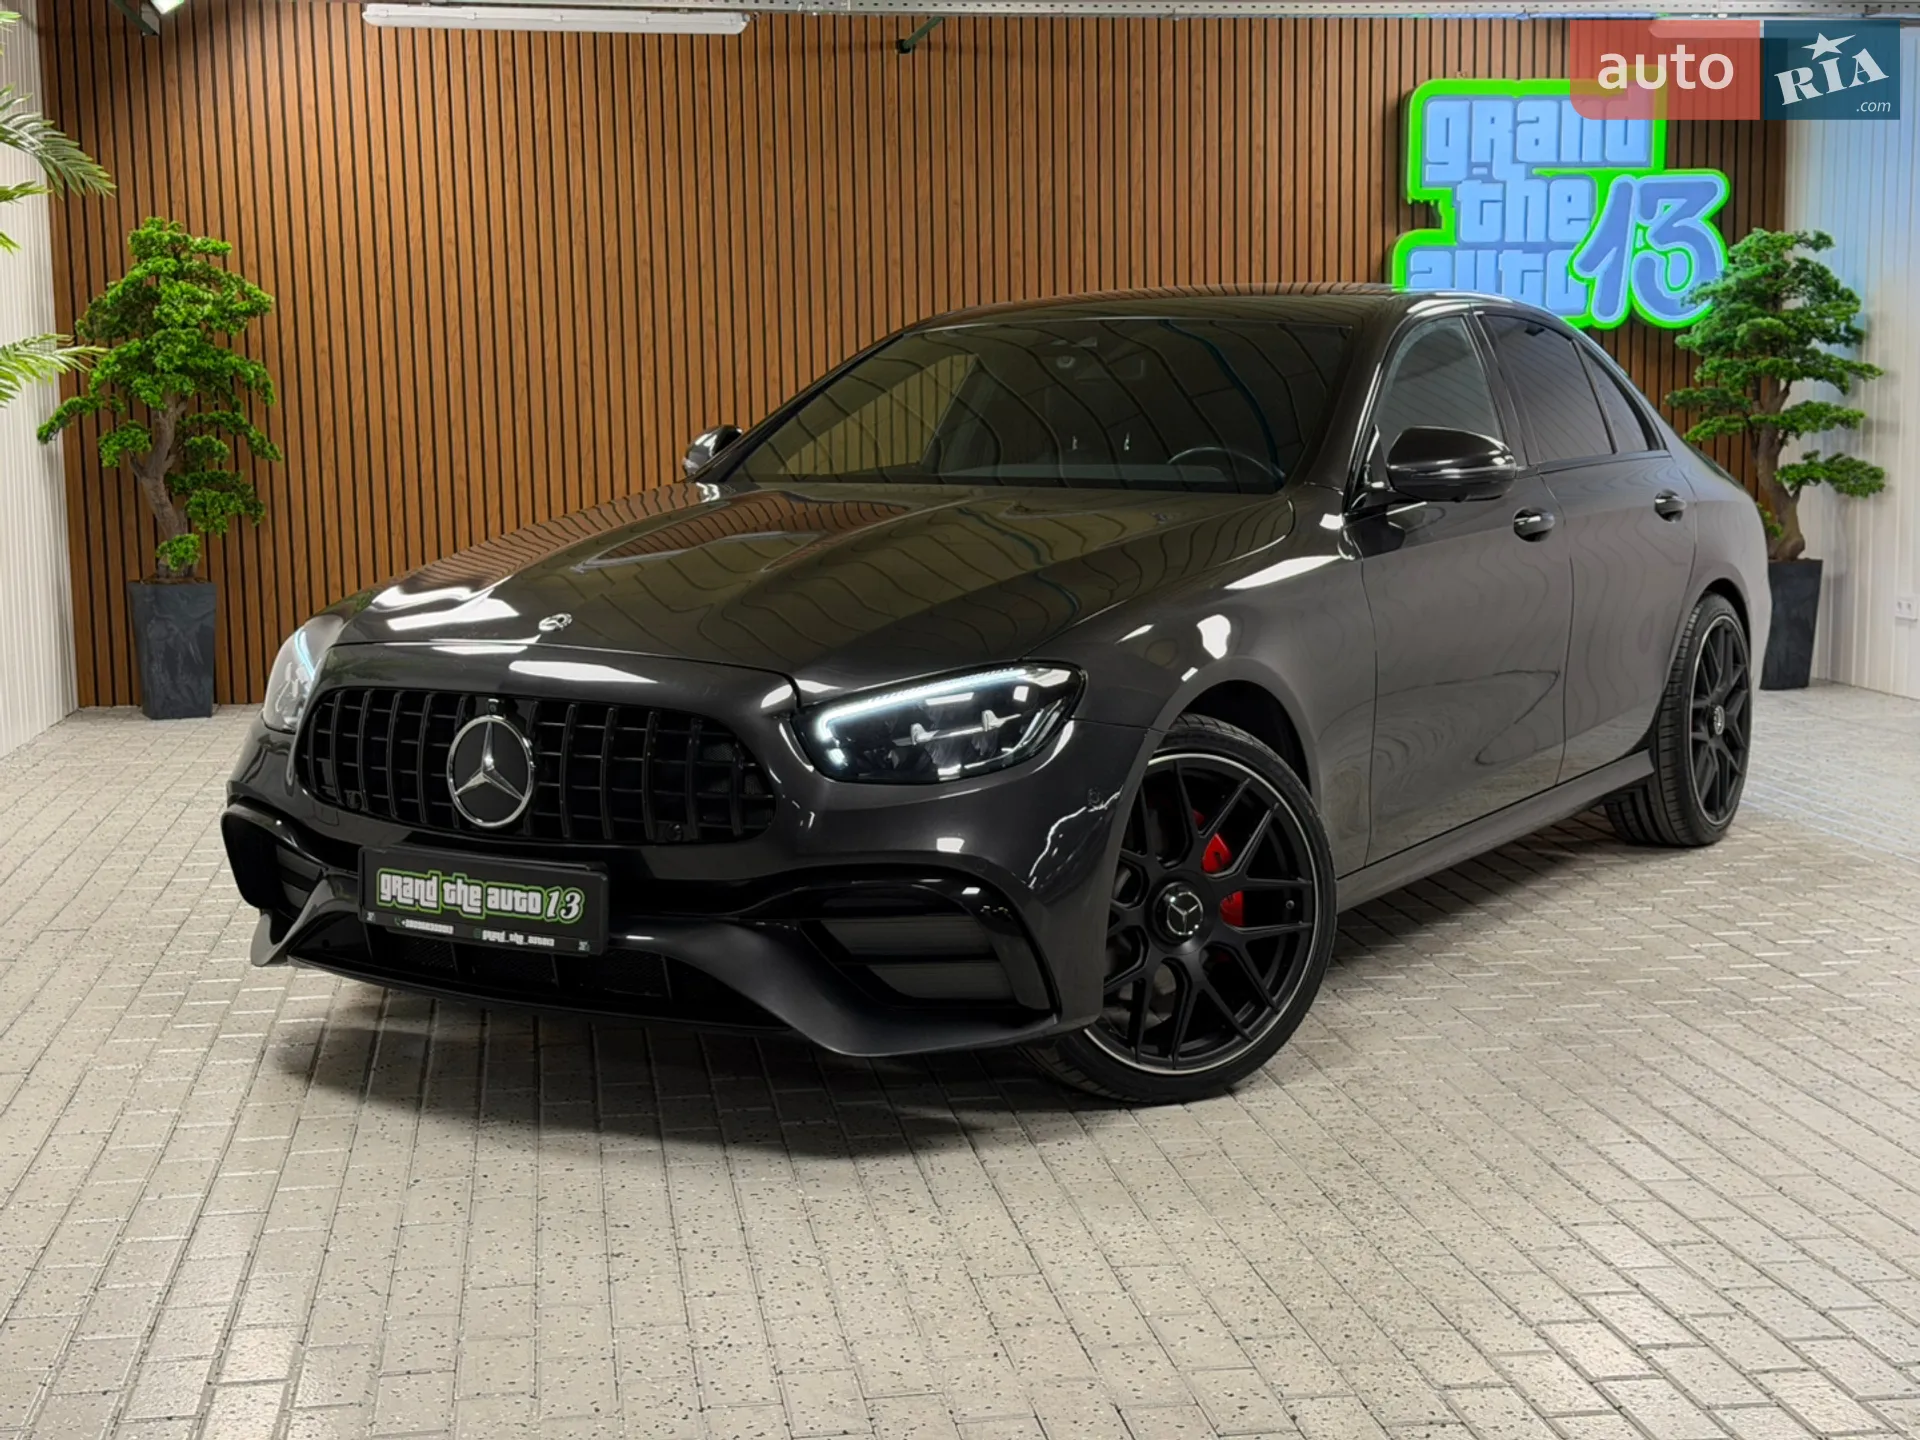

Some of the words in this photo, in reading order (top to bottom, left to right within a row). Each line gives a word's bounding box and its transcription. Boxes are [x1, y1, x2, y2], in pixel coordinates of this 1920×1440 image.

[1424, 83, 1650, 182] grand
[1410, 249, 1588, 316] auto
[1573, 174, 1727, 321] 13
[1455, 163, 1592, 243] the
[379, 873, 438, 908] grand
[443, 880, 483, 914] the
[486, 887, 543, 915] auto
[545, 890, 583, 920] 13
